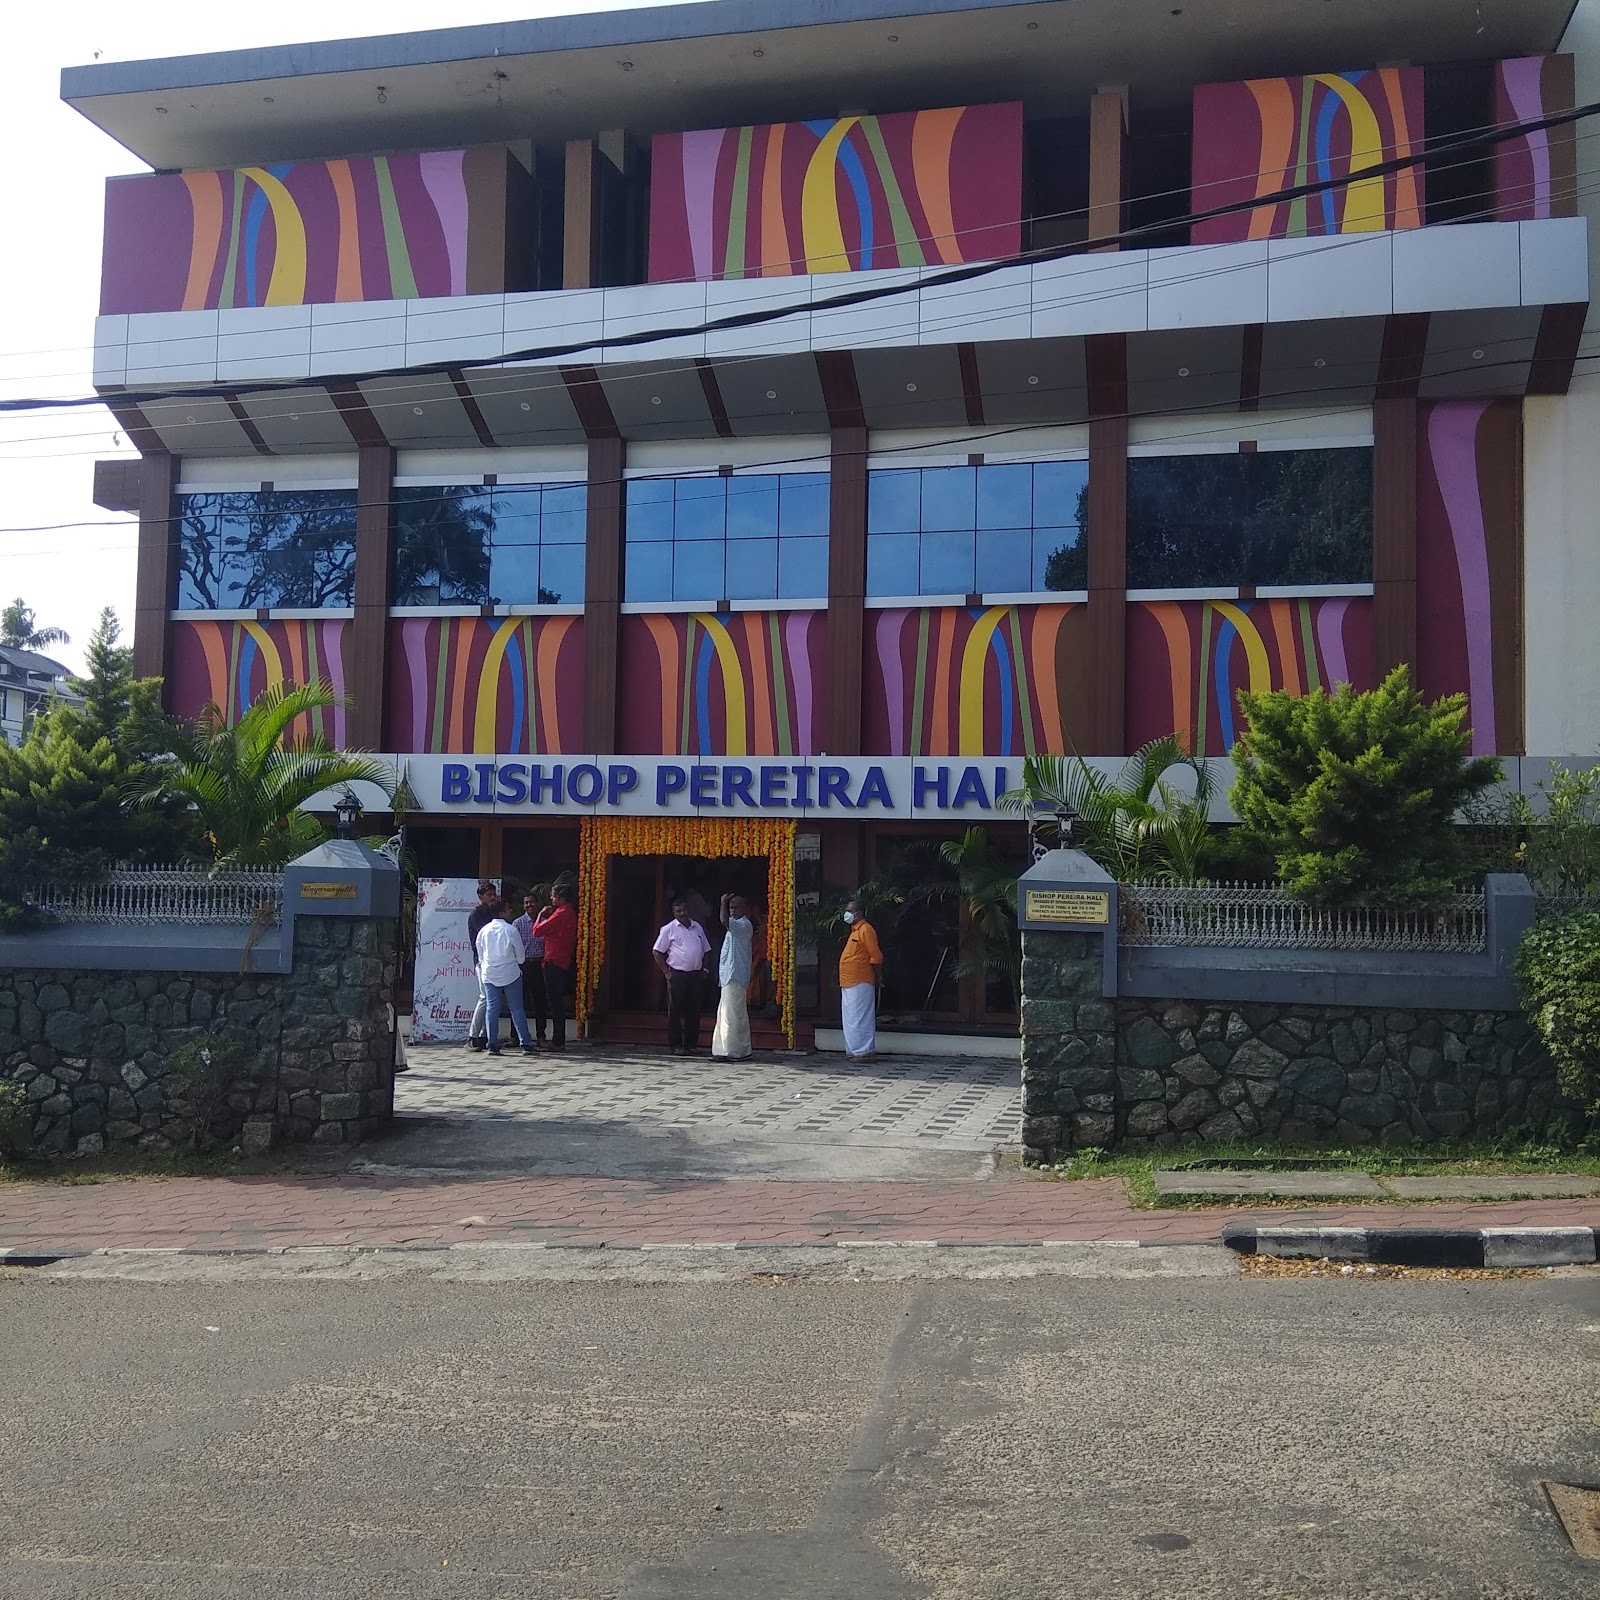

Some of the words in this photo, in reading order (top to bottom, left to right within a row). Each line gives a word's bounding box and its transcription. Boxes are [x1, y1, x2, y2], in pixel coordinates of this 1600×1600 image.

[441, 756, 638, 806] BISHOP
[655, 759, 895, 808] PEREIRA
[913, 766, 1057, 811] HAL
[432, 941, 470, 951] MANA
[451, 954, 462, 963] &
[453, 1005, 475, 1019] EVENT
